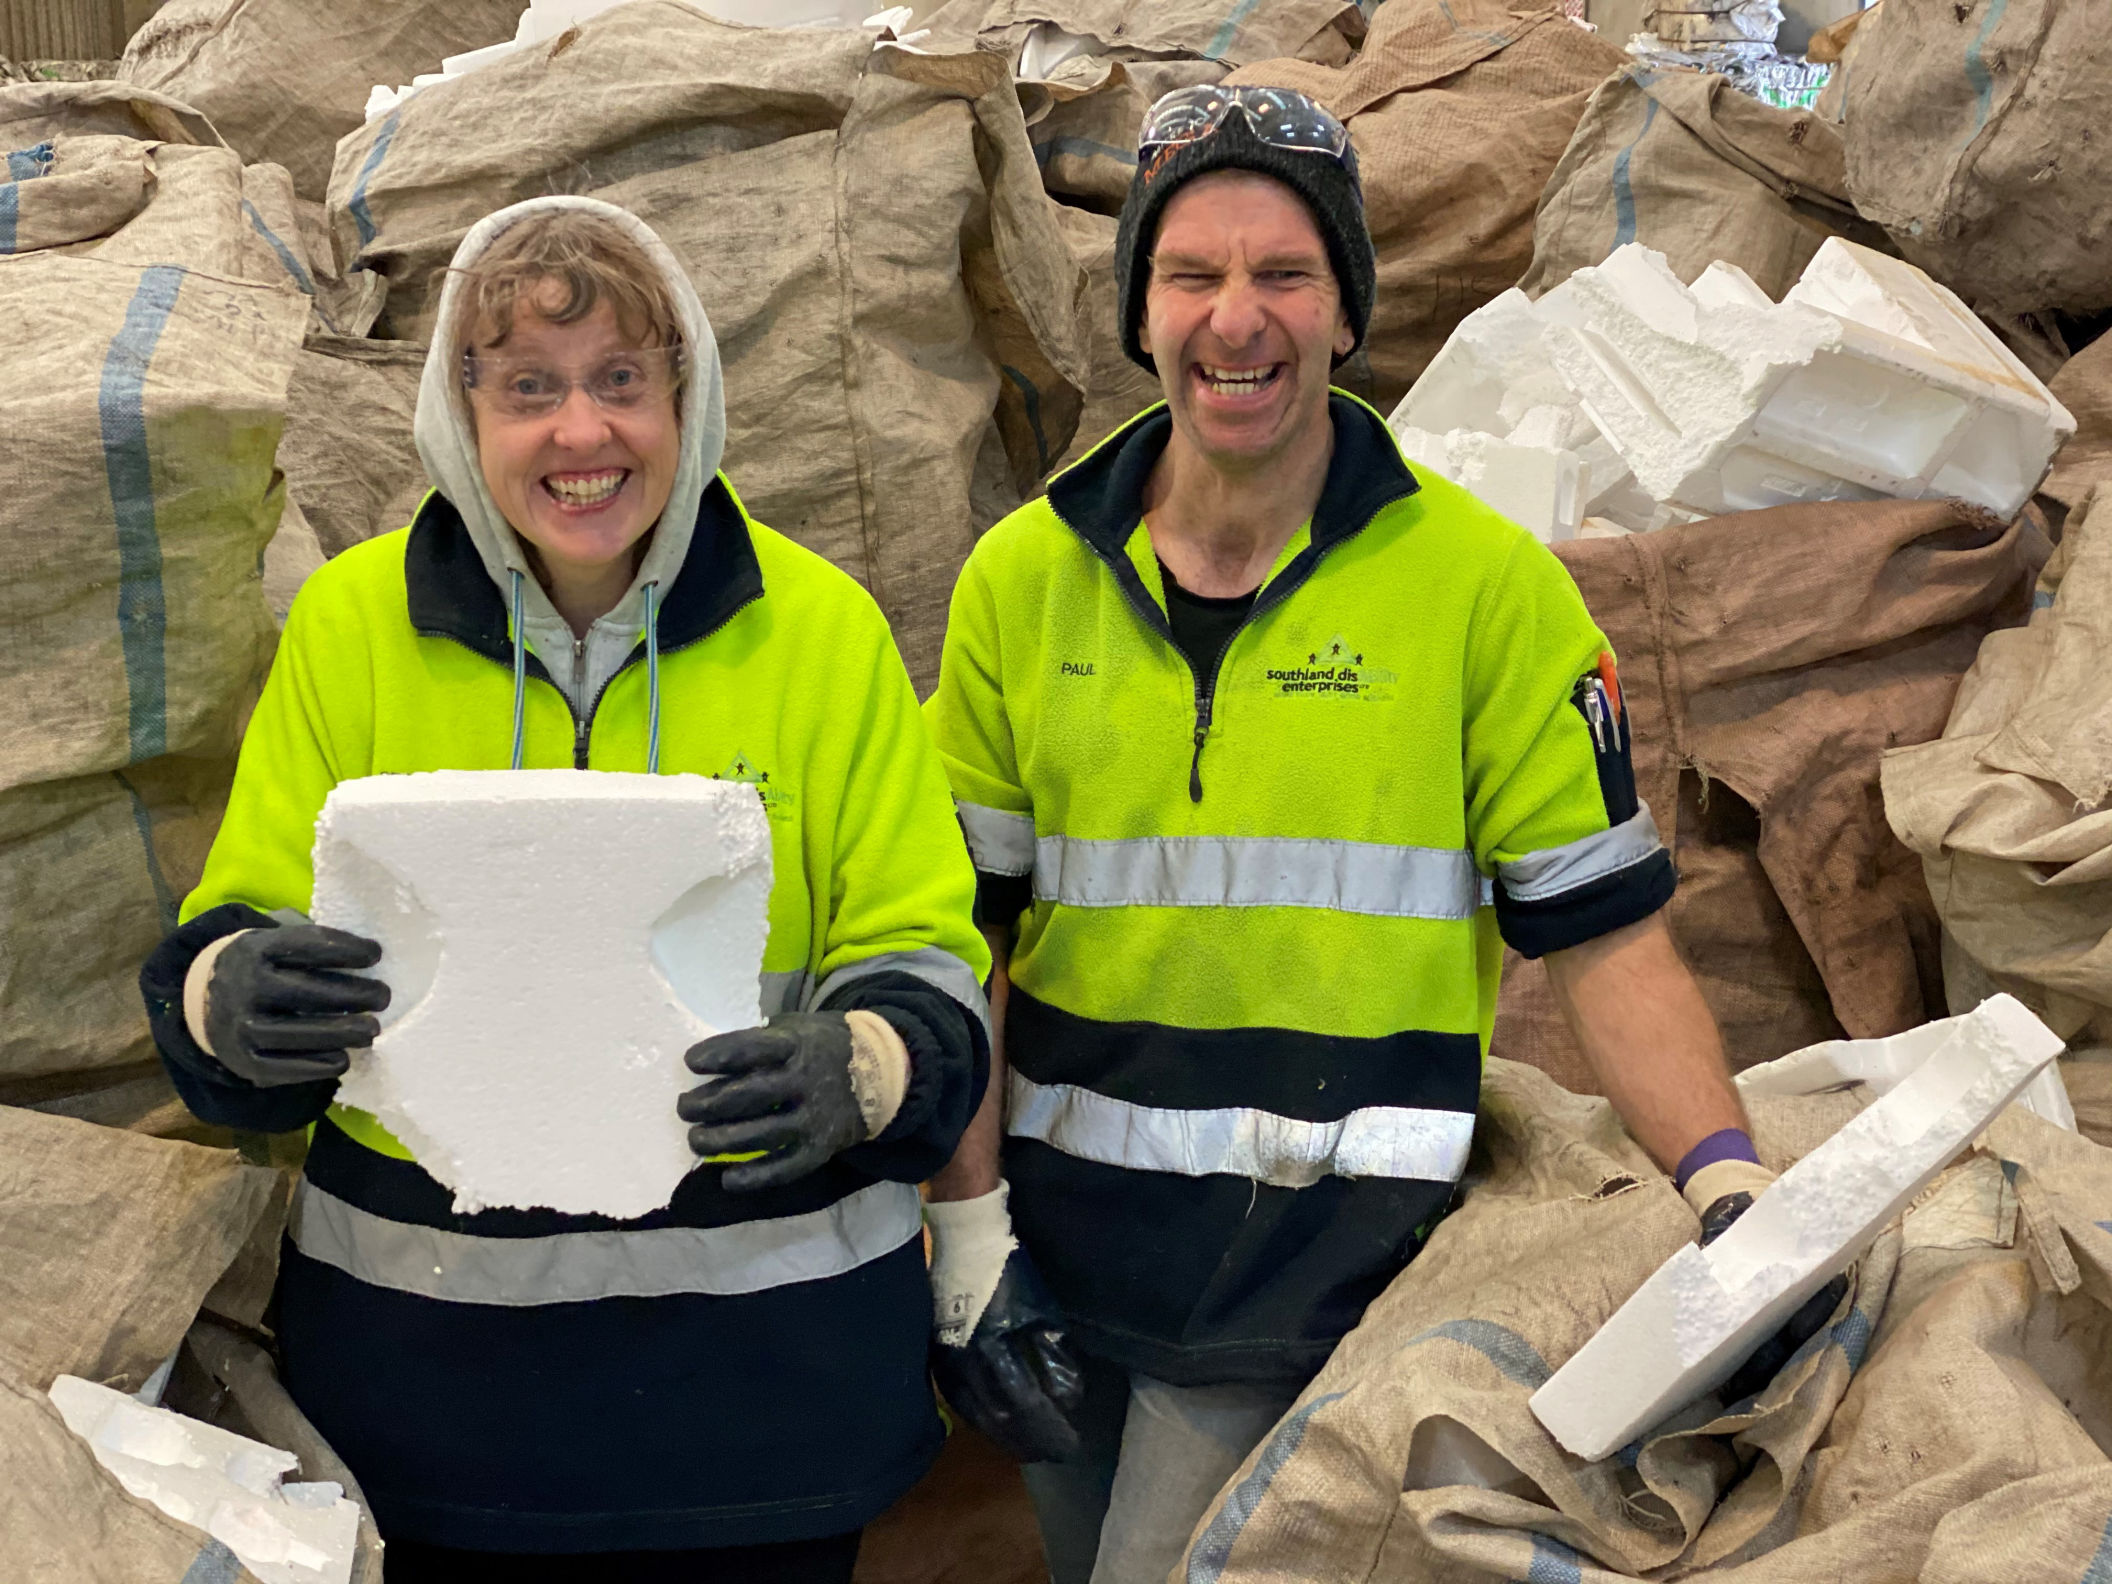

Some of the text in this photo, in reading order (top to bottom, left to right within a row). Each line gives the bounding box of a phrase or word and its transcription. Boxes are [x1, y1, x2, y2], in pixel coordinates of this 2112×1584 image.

[1061, 662, 1096, 676] PAUL
[1266, 667, 1335, 681] southland
[1281, 681, 1359, 693] enterprises
